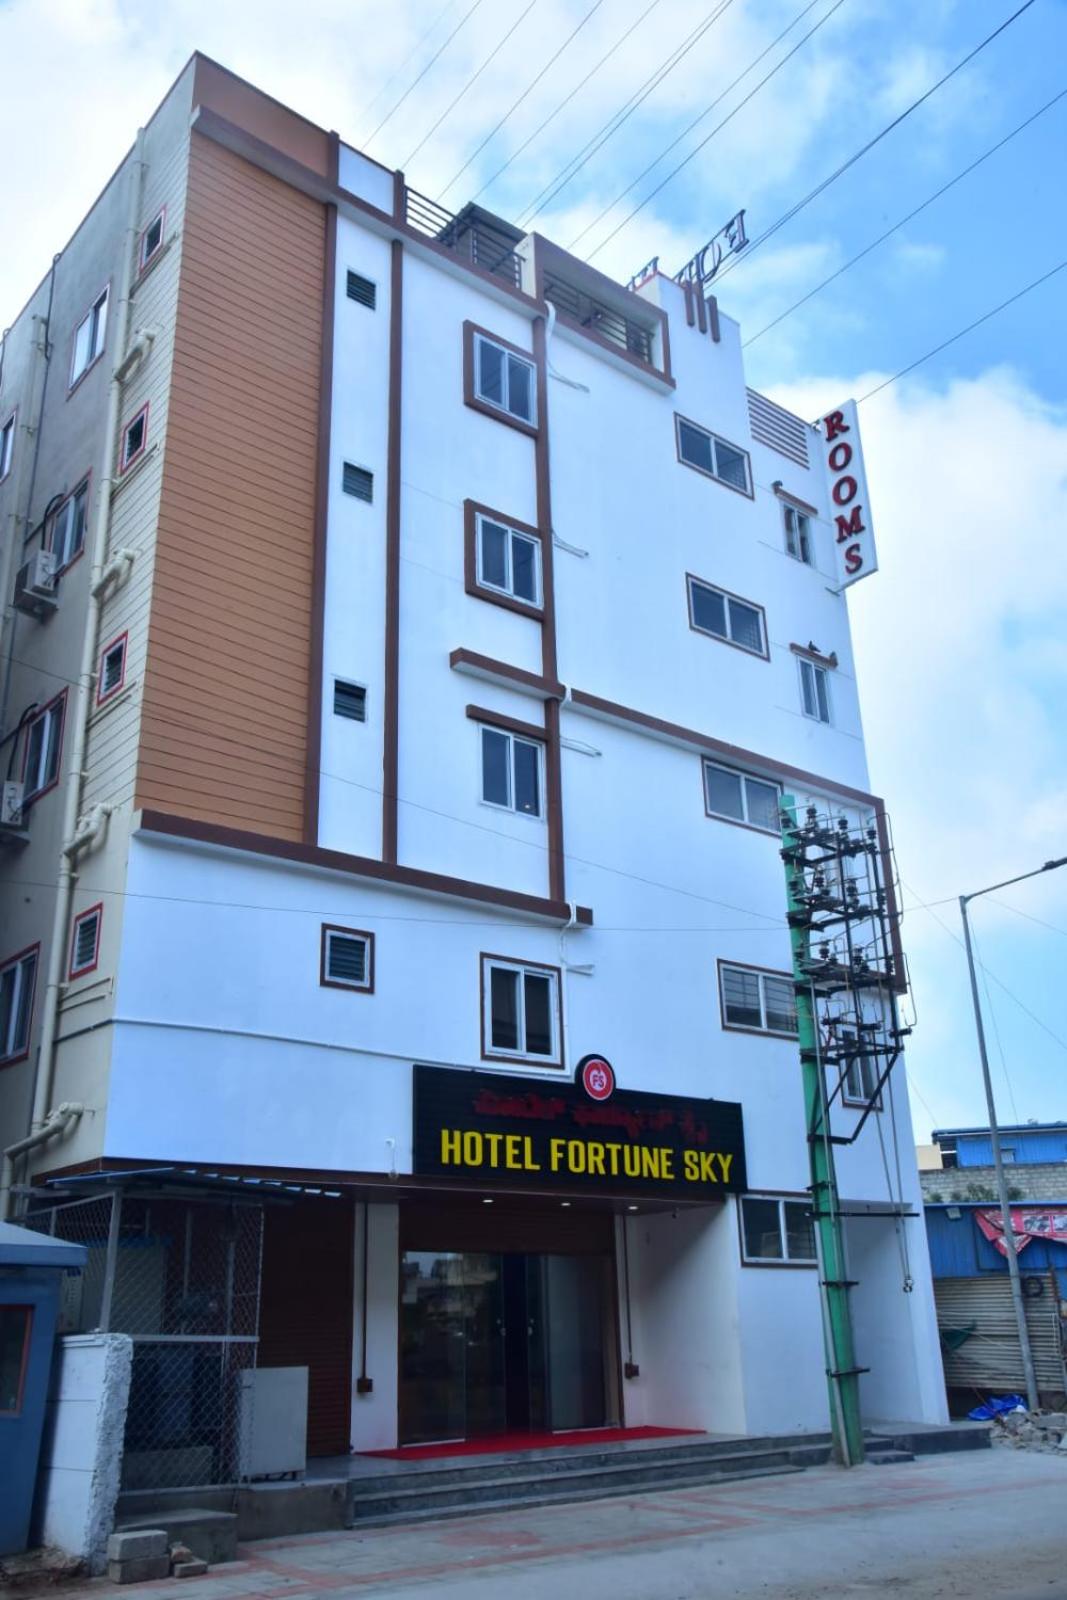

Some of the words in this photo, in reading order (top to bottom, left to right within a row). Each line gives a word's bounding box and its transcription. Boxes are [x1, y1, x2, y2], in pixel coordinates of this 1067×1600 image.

[823, 410, 866, 574] ROOMS
[441, 1129, 541, 1171] HOTEL
[550, 1138, 675, 1180] FORTUNE
[684, 1150, 734, 1184] SKY
